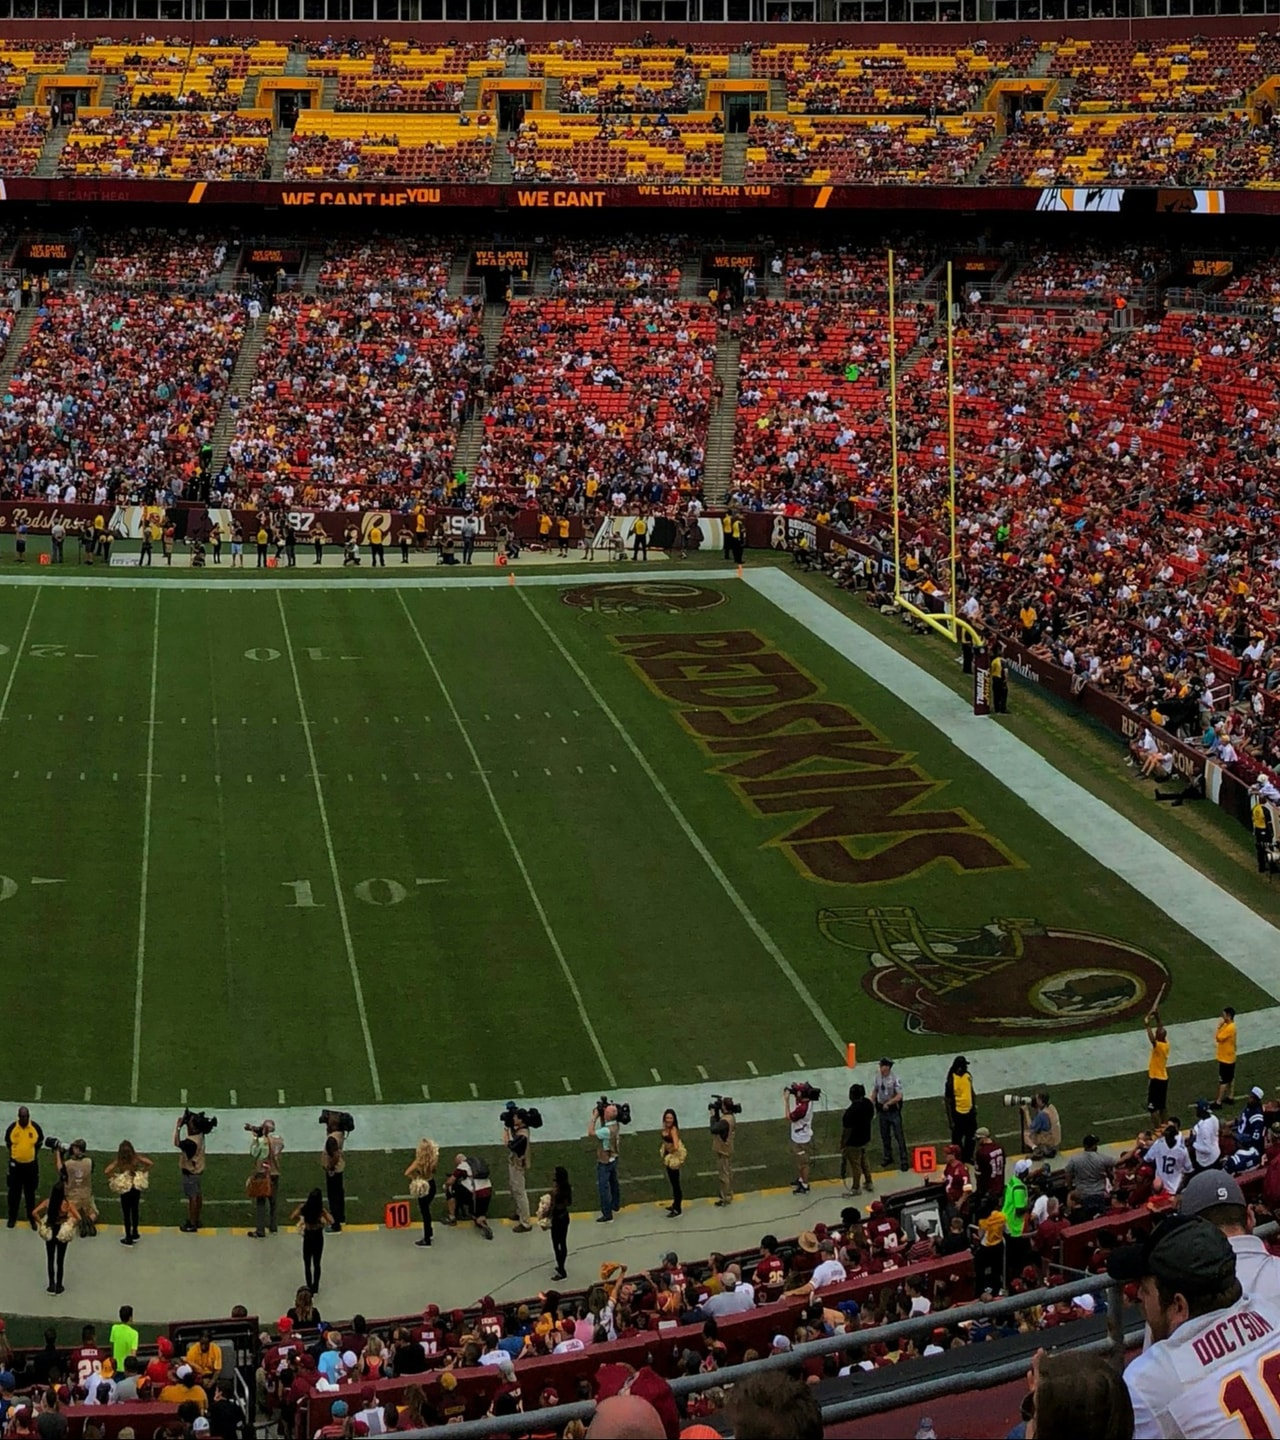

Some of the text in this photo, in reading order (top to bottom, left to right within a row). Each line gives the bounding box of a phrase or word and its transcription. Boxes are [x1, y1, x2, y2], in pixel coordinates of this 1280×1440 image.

[406, 189, 441, 202] YOU
[518, 191, 607, 207] WE CANT
[637, 186, 661, 195] WE
[702, 186, 739, 196] HEAR
[608, 628, 1032, 888] REDSKINS
[282, 878, 408, 907] 10
[919, 1150, 932, 1170] G
[1162, 1154, 1176, 1175] 12
[389, 1203, 410, 1228] 10
[1191, 1309, 1275, 1367] DOCTSON
